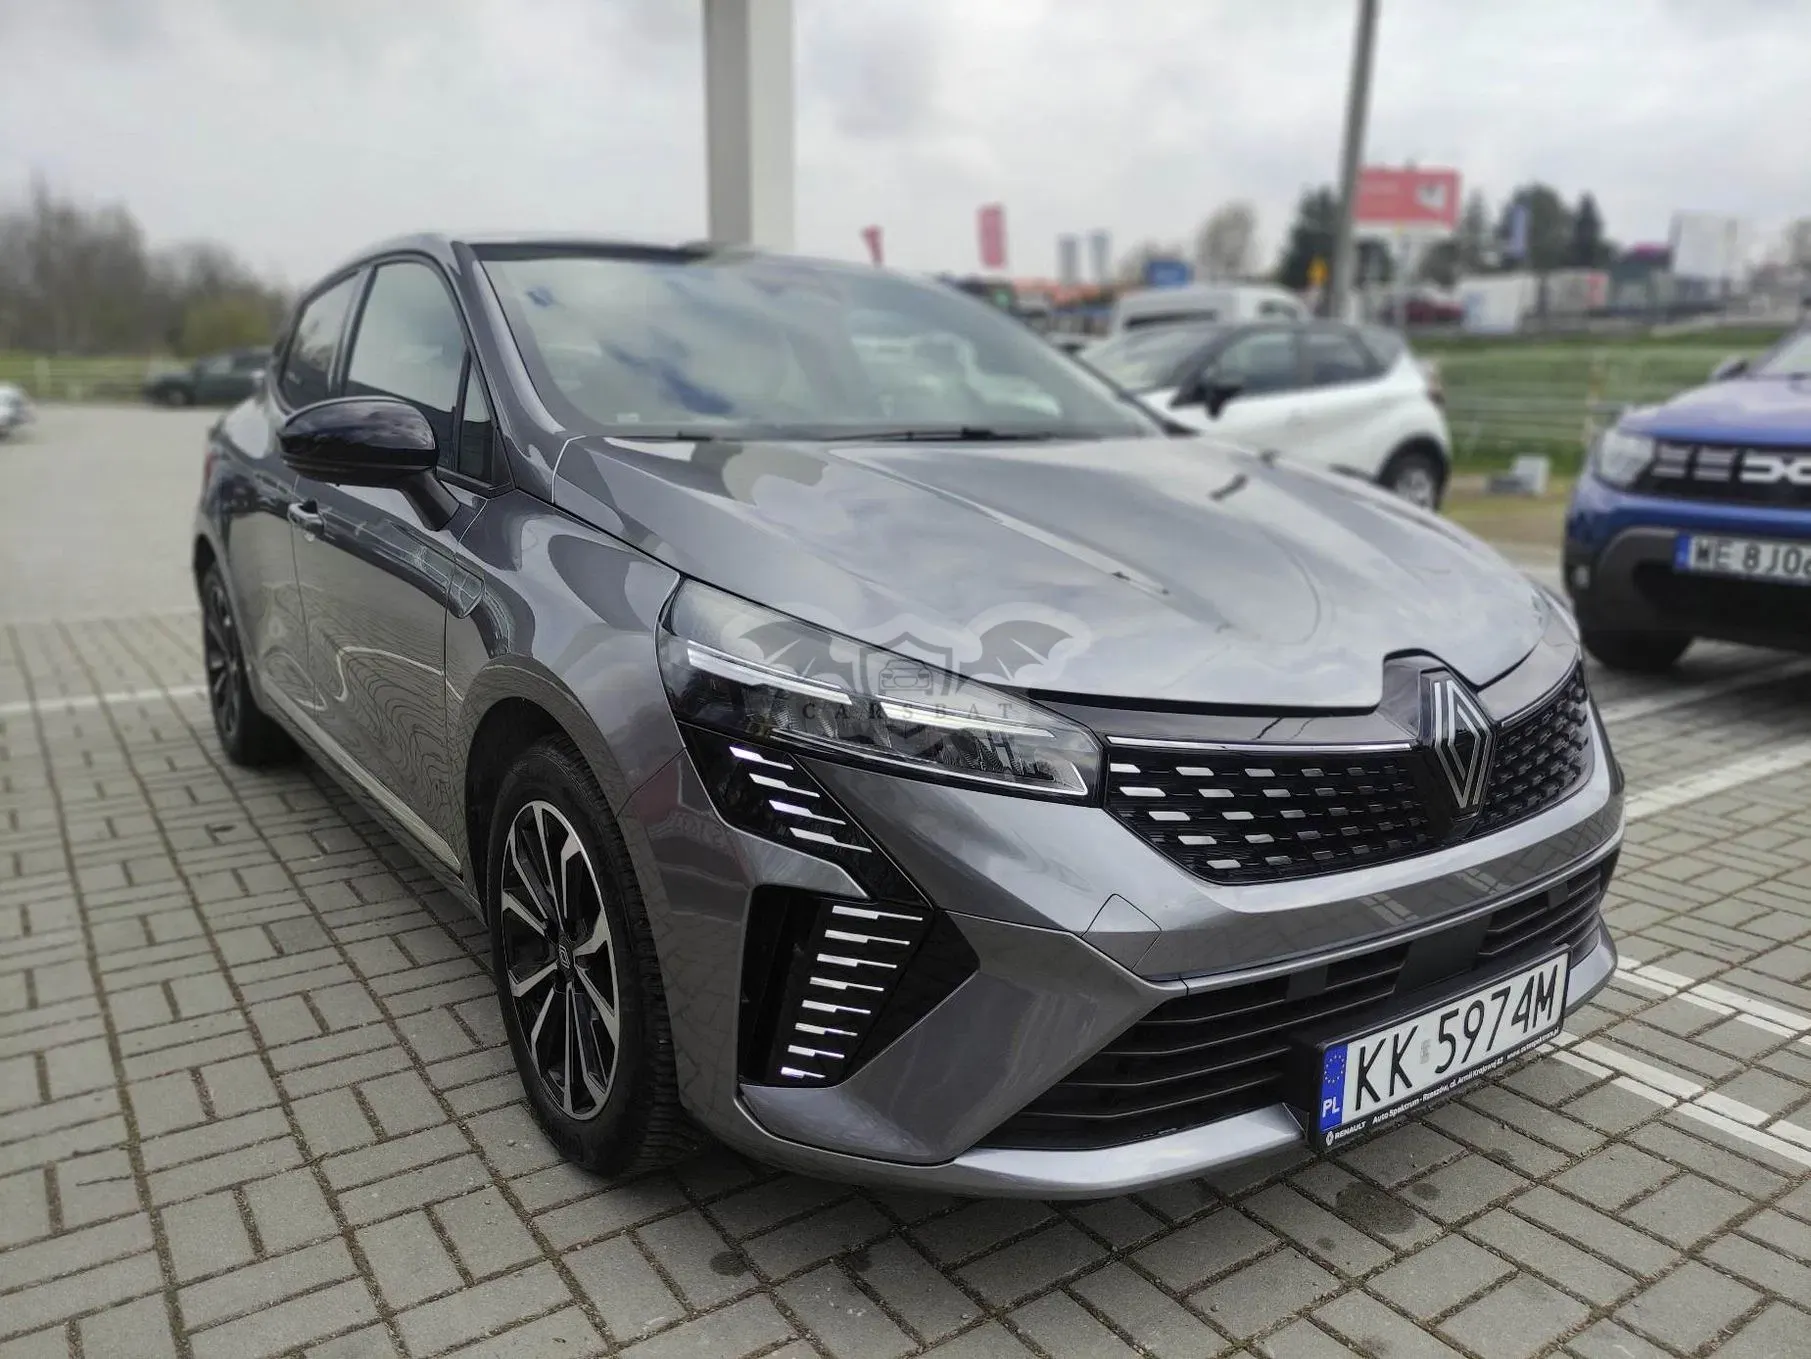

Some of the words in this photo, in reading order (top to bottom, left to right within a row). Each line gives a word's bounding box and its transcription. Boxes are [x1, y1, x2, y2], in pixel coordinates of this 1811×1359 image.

[1355, 1025, 1418, 1112] KK
[1435, 964, 1558, 1074] 5974M
[1322, 1097, 1340, 1118] PL
[1334, 1121, 1366, 1139] RENAULT
[1372, 1110, 1389, 1125] Auto
